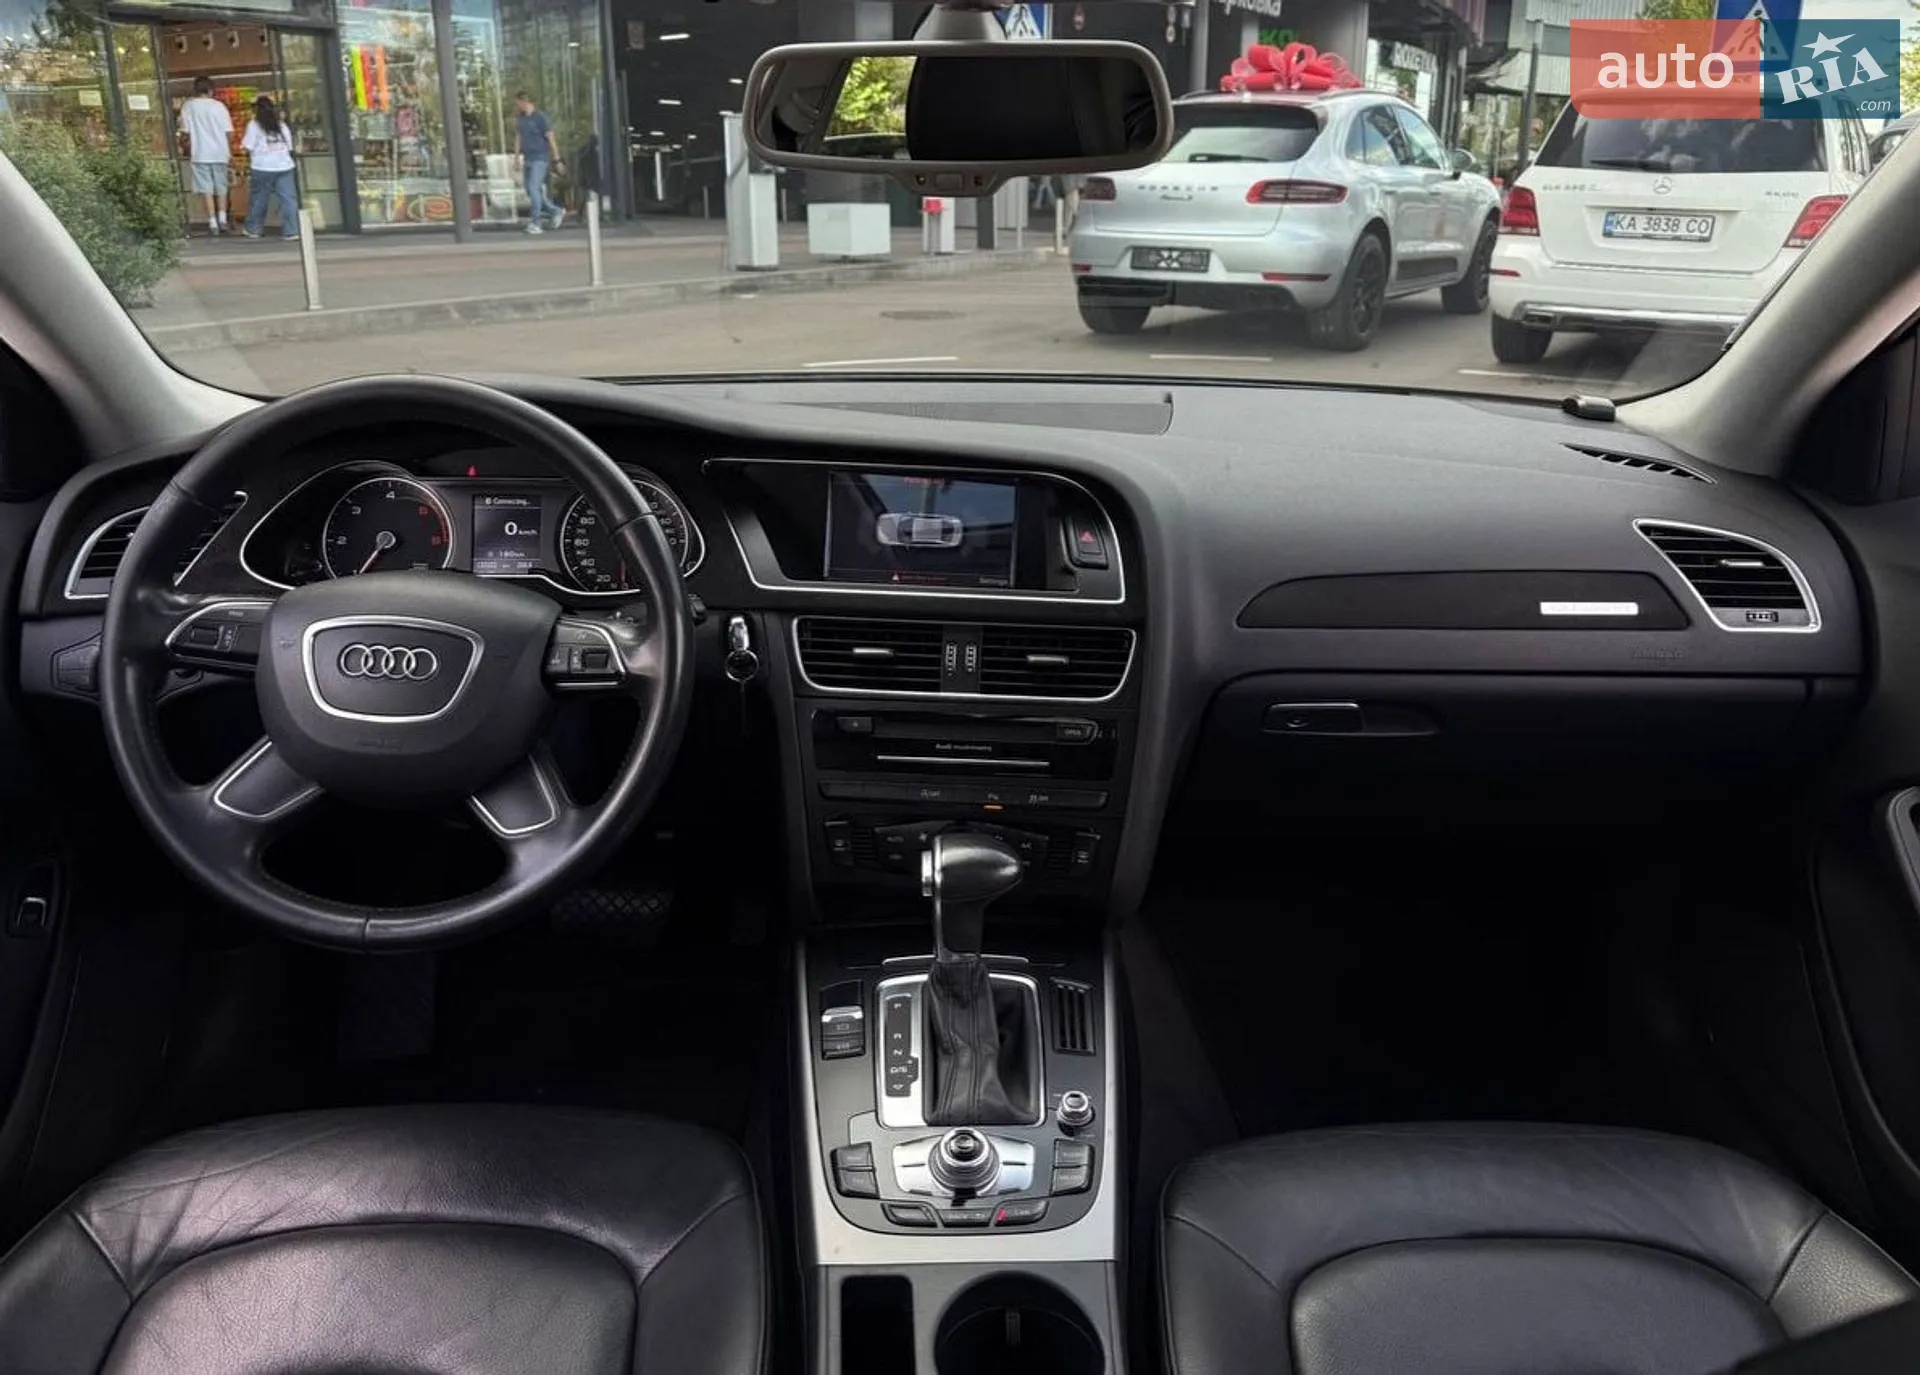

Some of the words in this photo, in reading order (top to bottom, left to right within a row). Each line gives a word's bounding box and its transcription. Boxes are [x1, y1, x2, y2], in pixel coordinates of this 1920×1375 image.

[1614, 213, 1637, 230] KA
[1643, 216, 1681, 233] 3838
[1686, 218, 1710, 234] CO
[504, 521, 518, 535] 0
